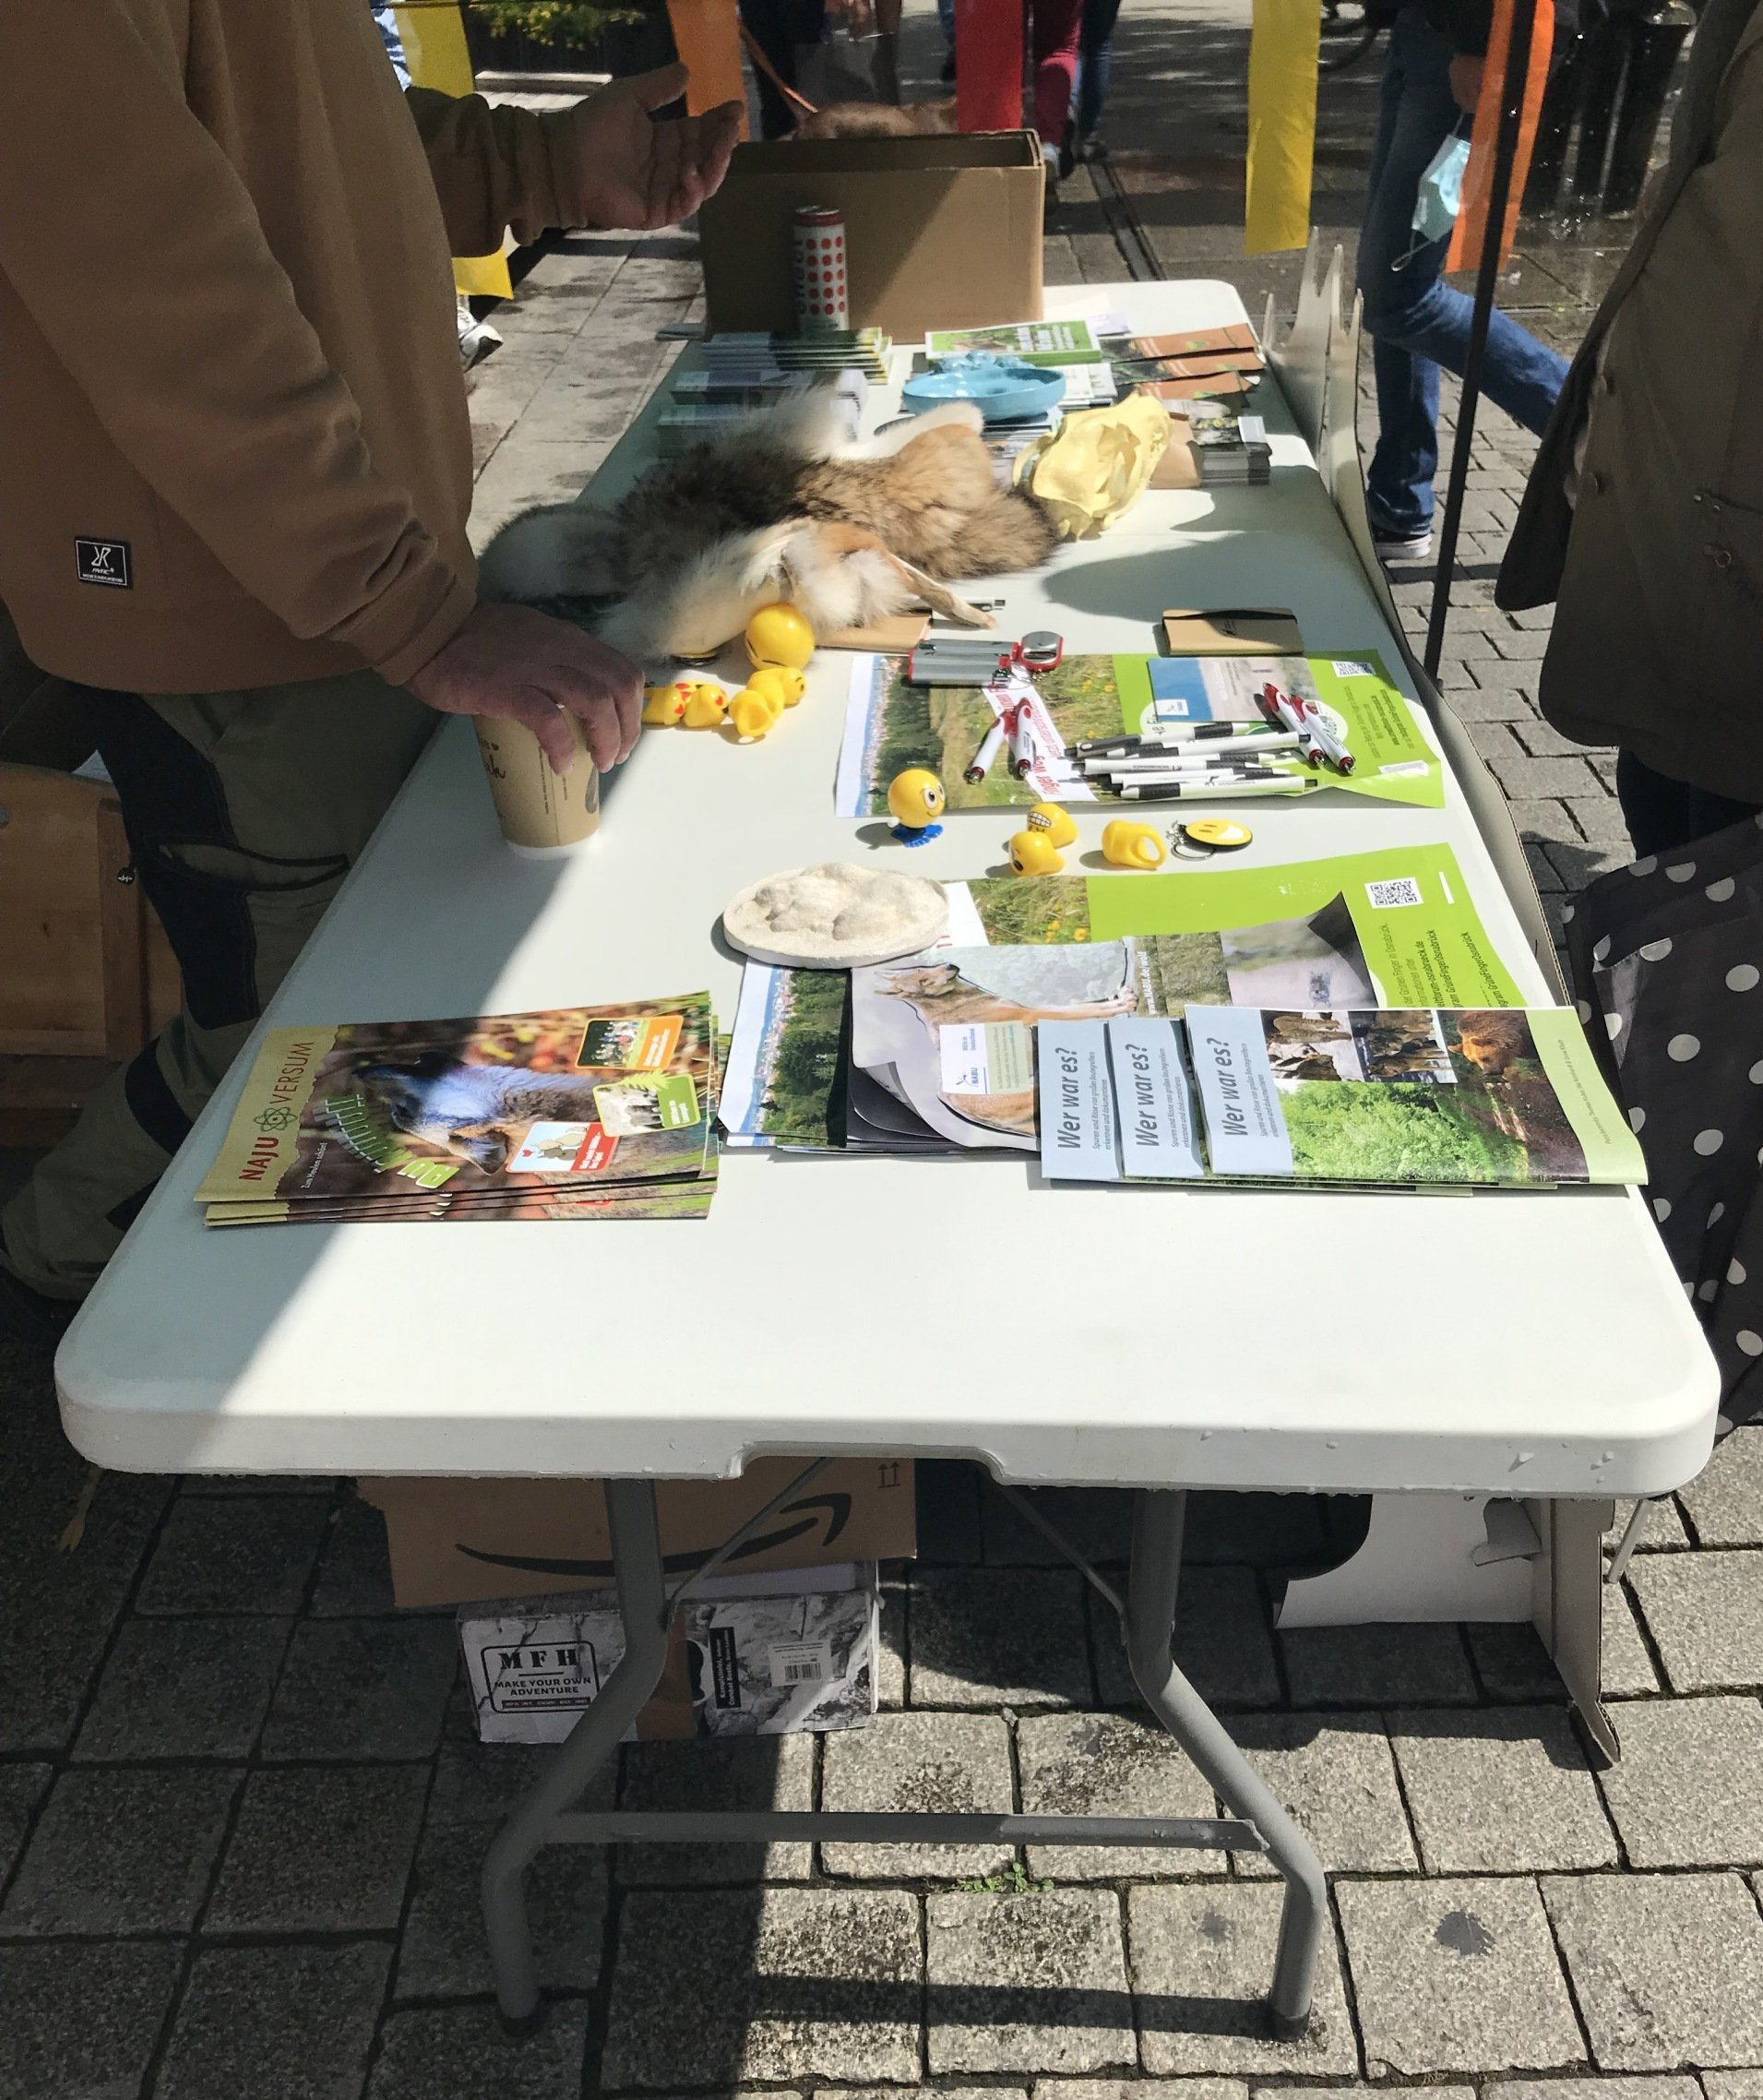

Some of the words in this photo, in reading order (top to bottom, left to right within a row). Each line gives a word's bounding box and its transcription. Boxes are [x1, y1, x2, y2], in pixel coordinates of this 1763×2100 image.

[1390, 960, 1404, 976] Finger
[1405, 958, 1417, 971] unter
[1426, 929, 1456, 993] GrüneFingerOsnabrück
[1460, 932, 1497, 990] GrüneFingerOsnabrück
[1396, 976, 1411, 996] Grünen
[1415, 940, 1445, 1008] eltforum-osnabrueck.de
[1402, 996, 1413, 1004] der
[1411, 971, 1427, 1007] nformationen
[1055, 1047, 1078, 1073] es?
[1125, 1044, 1149, 1070] es?
[1207, 1038, 1232, 1067] es?
[971, 1068, 979, 1084] NABU
[1217, 1069, 1240, 1100] war
[1061, 1077, 1079, 1107] war
[1134, 1074, 1154, 1105] war
[238, 1137, 279, 1181] NAJU
[269, 1042, 314, 1105] VERSUM
[1102, 1115, 1110, 1124] und
[1178, 1113, 1186, 1123] und
[1221, 1104, 1247, 1136] Wer
[1057, 1112, 1080, 1149] Wer
[1090, 1119, 1099, 1129] und
[1136, 1111, 1159, 1146] Wer
[1179, 1124, 1189, 1148] erkennen
[1091, 1131, 1101, 1149] Spuren
[1103, 1126, 1112, 1150] erkennen
[1170, 1129, 1179, 1148] Spuren
[315, 1142, 328, 1159] schön!
[305, 1159, 321, 1177] Heulen
[301, 1178, 314, 1188] Zum
[510, 1687, 578, 1696] ADVENTURE
[563, 1676, 591, 1685] OWN
